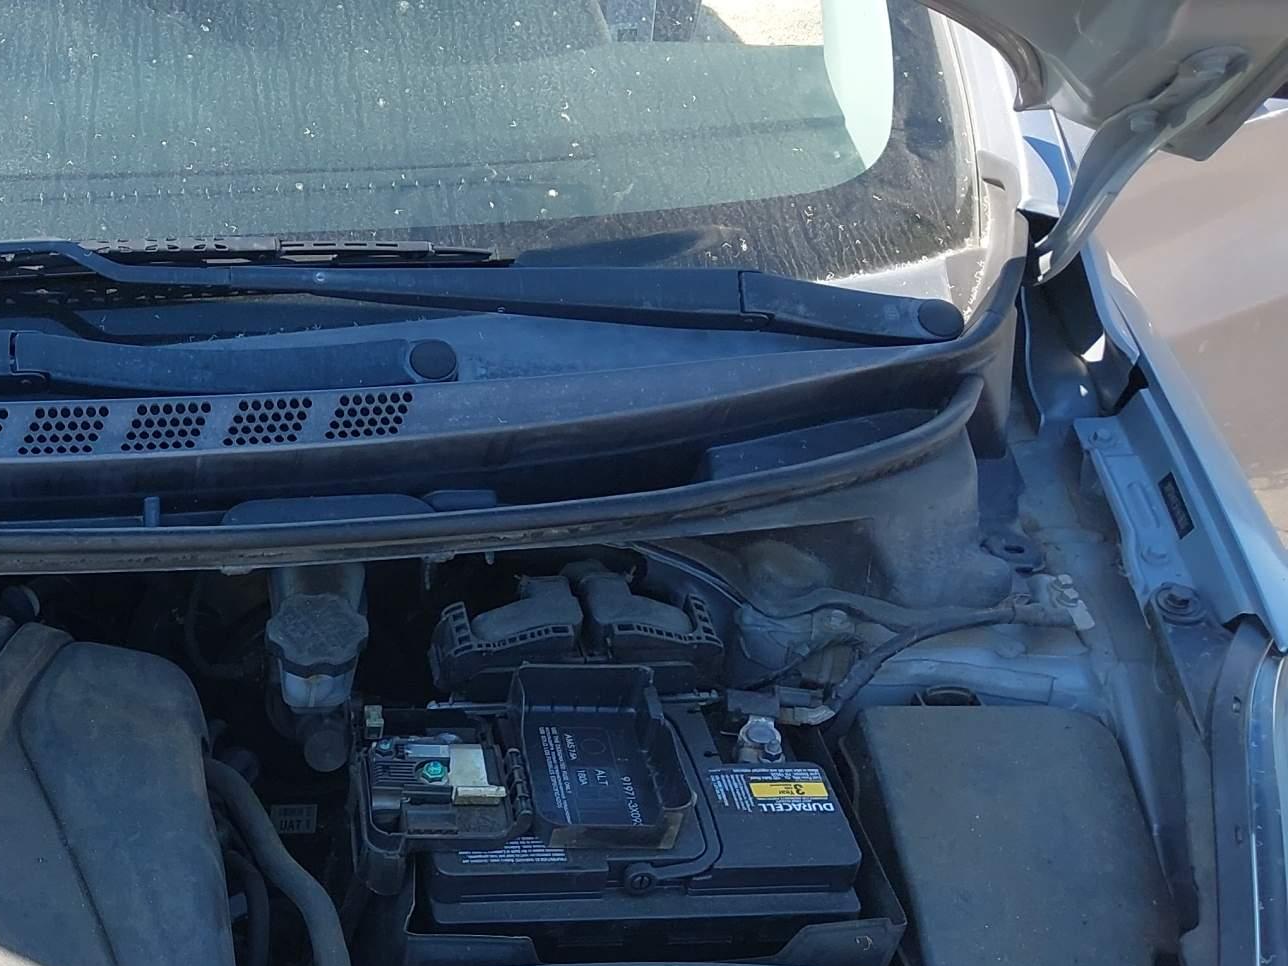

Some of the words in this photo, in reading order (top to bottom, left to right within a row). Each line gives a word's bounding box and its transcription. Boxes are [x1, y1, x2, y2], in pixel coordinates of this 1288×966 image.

[595, 769, 608, 786] ALT
[793, 784, 805, 795] 3
[759, 803, 835, 812] DURACELL
